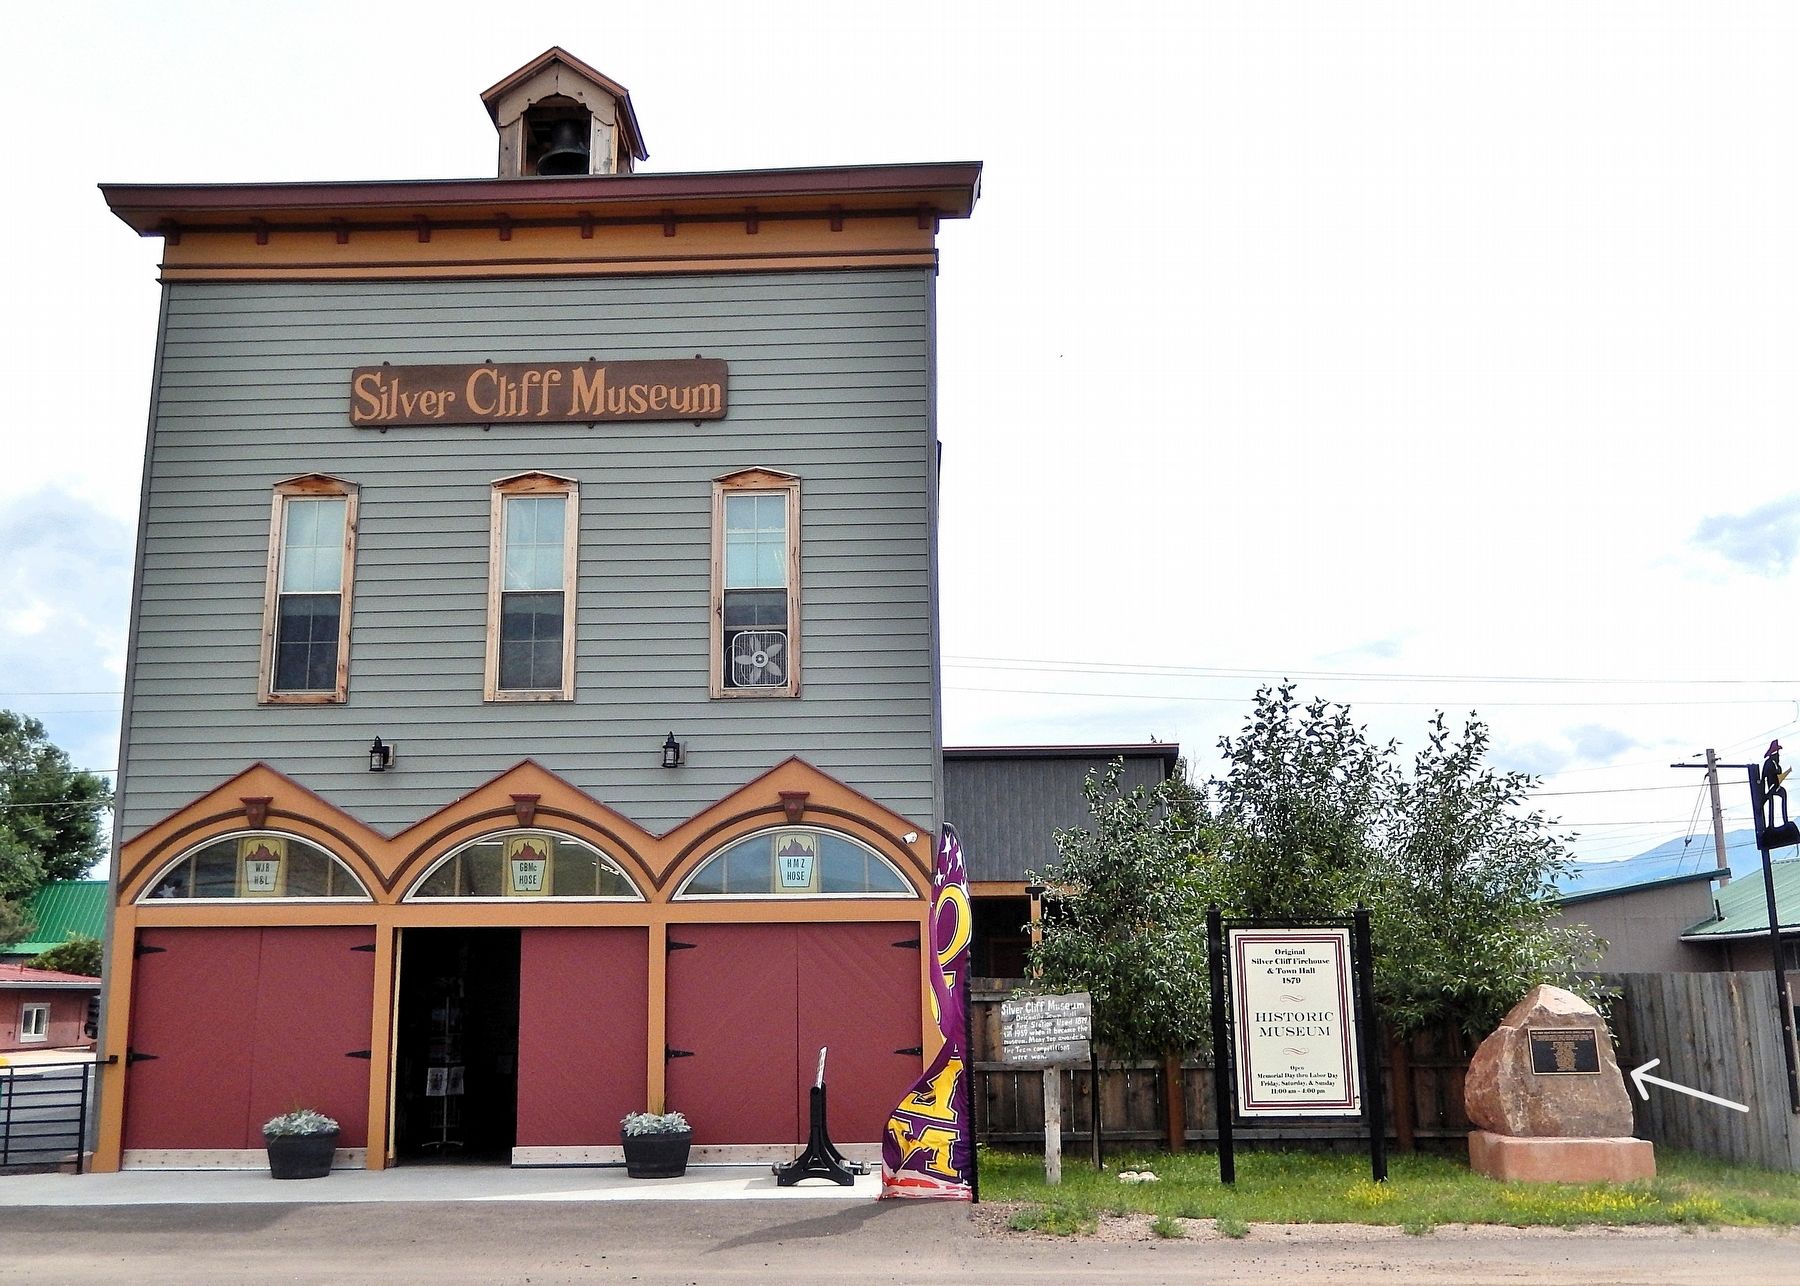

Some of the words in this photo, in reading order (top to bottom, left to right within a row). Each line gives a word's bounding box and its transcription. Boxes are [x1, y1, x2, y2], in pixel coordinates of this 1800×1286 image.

[354, 371, 456, 421] Silver
[465, 367, 561, 417] Cliff
[568, 366, 722, 416] Museum
[519, 875, 537, 884] HOSE
[787, 871, 805, 881] HOSE
[1274, 948, 1306, 956] Original
[1275, 957, 1292, 965] Cliff
[1266, 967, 1274, 975] &
[1001, 1003, 1024, 1016] Silver
[1025, 1001, 1046, 1014] Cliff
[1047, 999, 1085, 1011] Museum
[1255, 1011, 1334, 1022] HISTORIC
[1056, 1018, 1073, 1026] Used
[1014, 1029, 1028, 1037] 1959
[1053, 1026, 1076, 1034] became
[1259, 1026, 1330, 1037] MUSEUM
